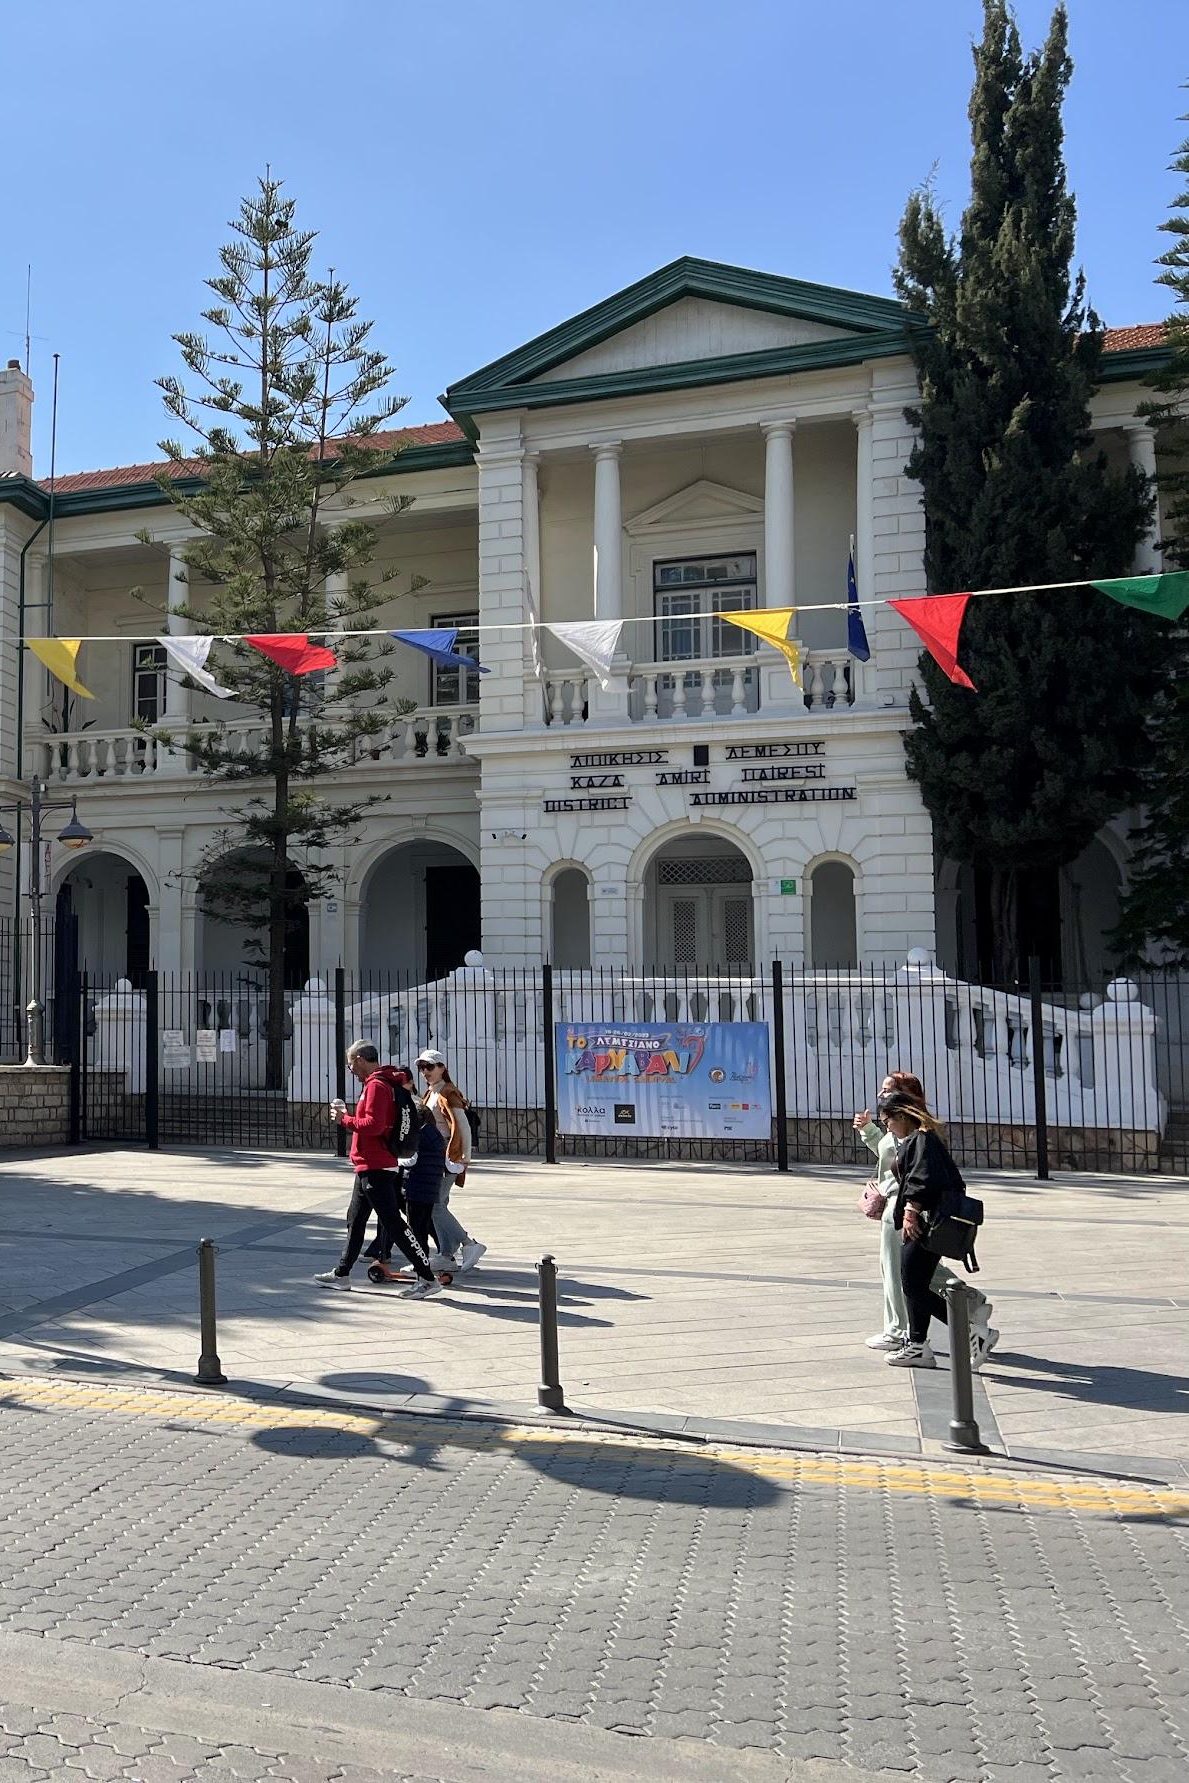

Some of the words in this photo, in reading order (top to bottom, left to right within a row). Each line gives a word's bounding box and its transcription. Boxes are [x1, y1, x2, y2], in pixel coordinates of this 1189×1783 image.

[571, 775, 625, 789] KAZA
[543, 797, 633, 812] DISTRICT
[689, 788, 857, 806] ADMINISTRATION
[596, 1037, 661, 1049] ΛΕΜΕΣΙΑΝΟ
[565, 1049, 690, 1075] ΚΑΡΝΑΒΑΛΙ
[404, 1228, 429, 1266] adidas
